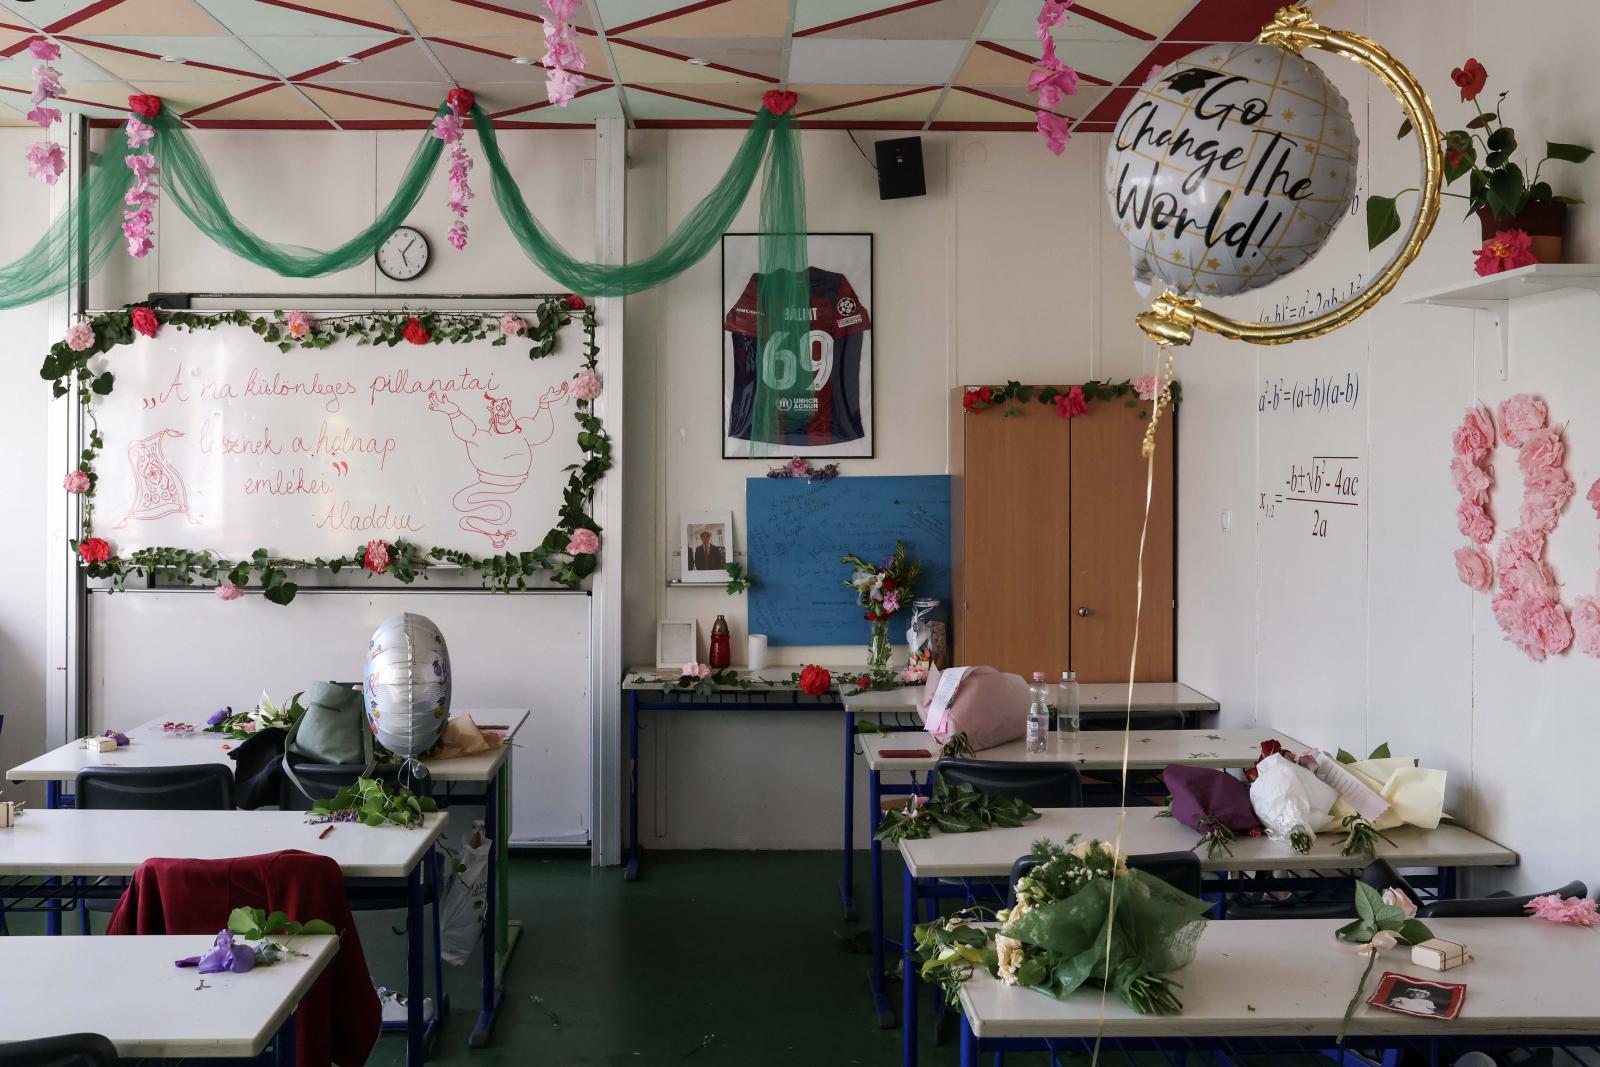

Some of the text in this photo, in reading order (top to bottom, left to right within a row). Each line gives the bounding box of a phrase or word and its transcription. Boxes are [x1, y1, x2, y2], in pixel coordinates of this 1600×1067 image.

[1195, 76, 1272, 131] Go
[1116, 101, 1247, 195] Change
[1252, 130, 1314, 200] The
[1117, 161, 1282, 258] World!
[762, 329, 834, 391] 69
[244, 368, 356, 413] különleges
[370, 367, 500, 406] pillanatai
[292, 436, 310, 453] a
[316, 419, 397, 471] holnap
